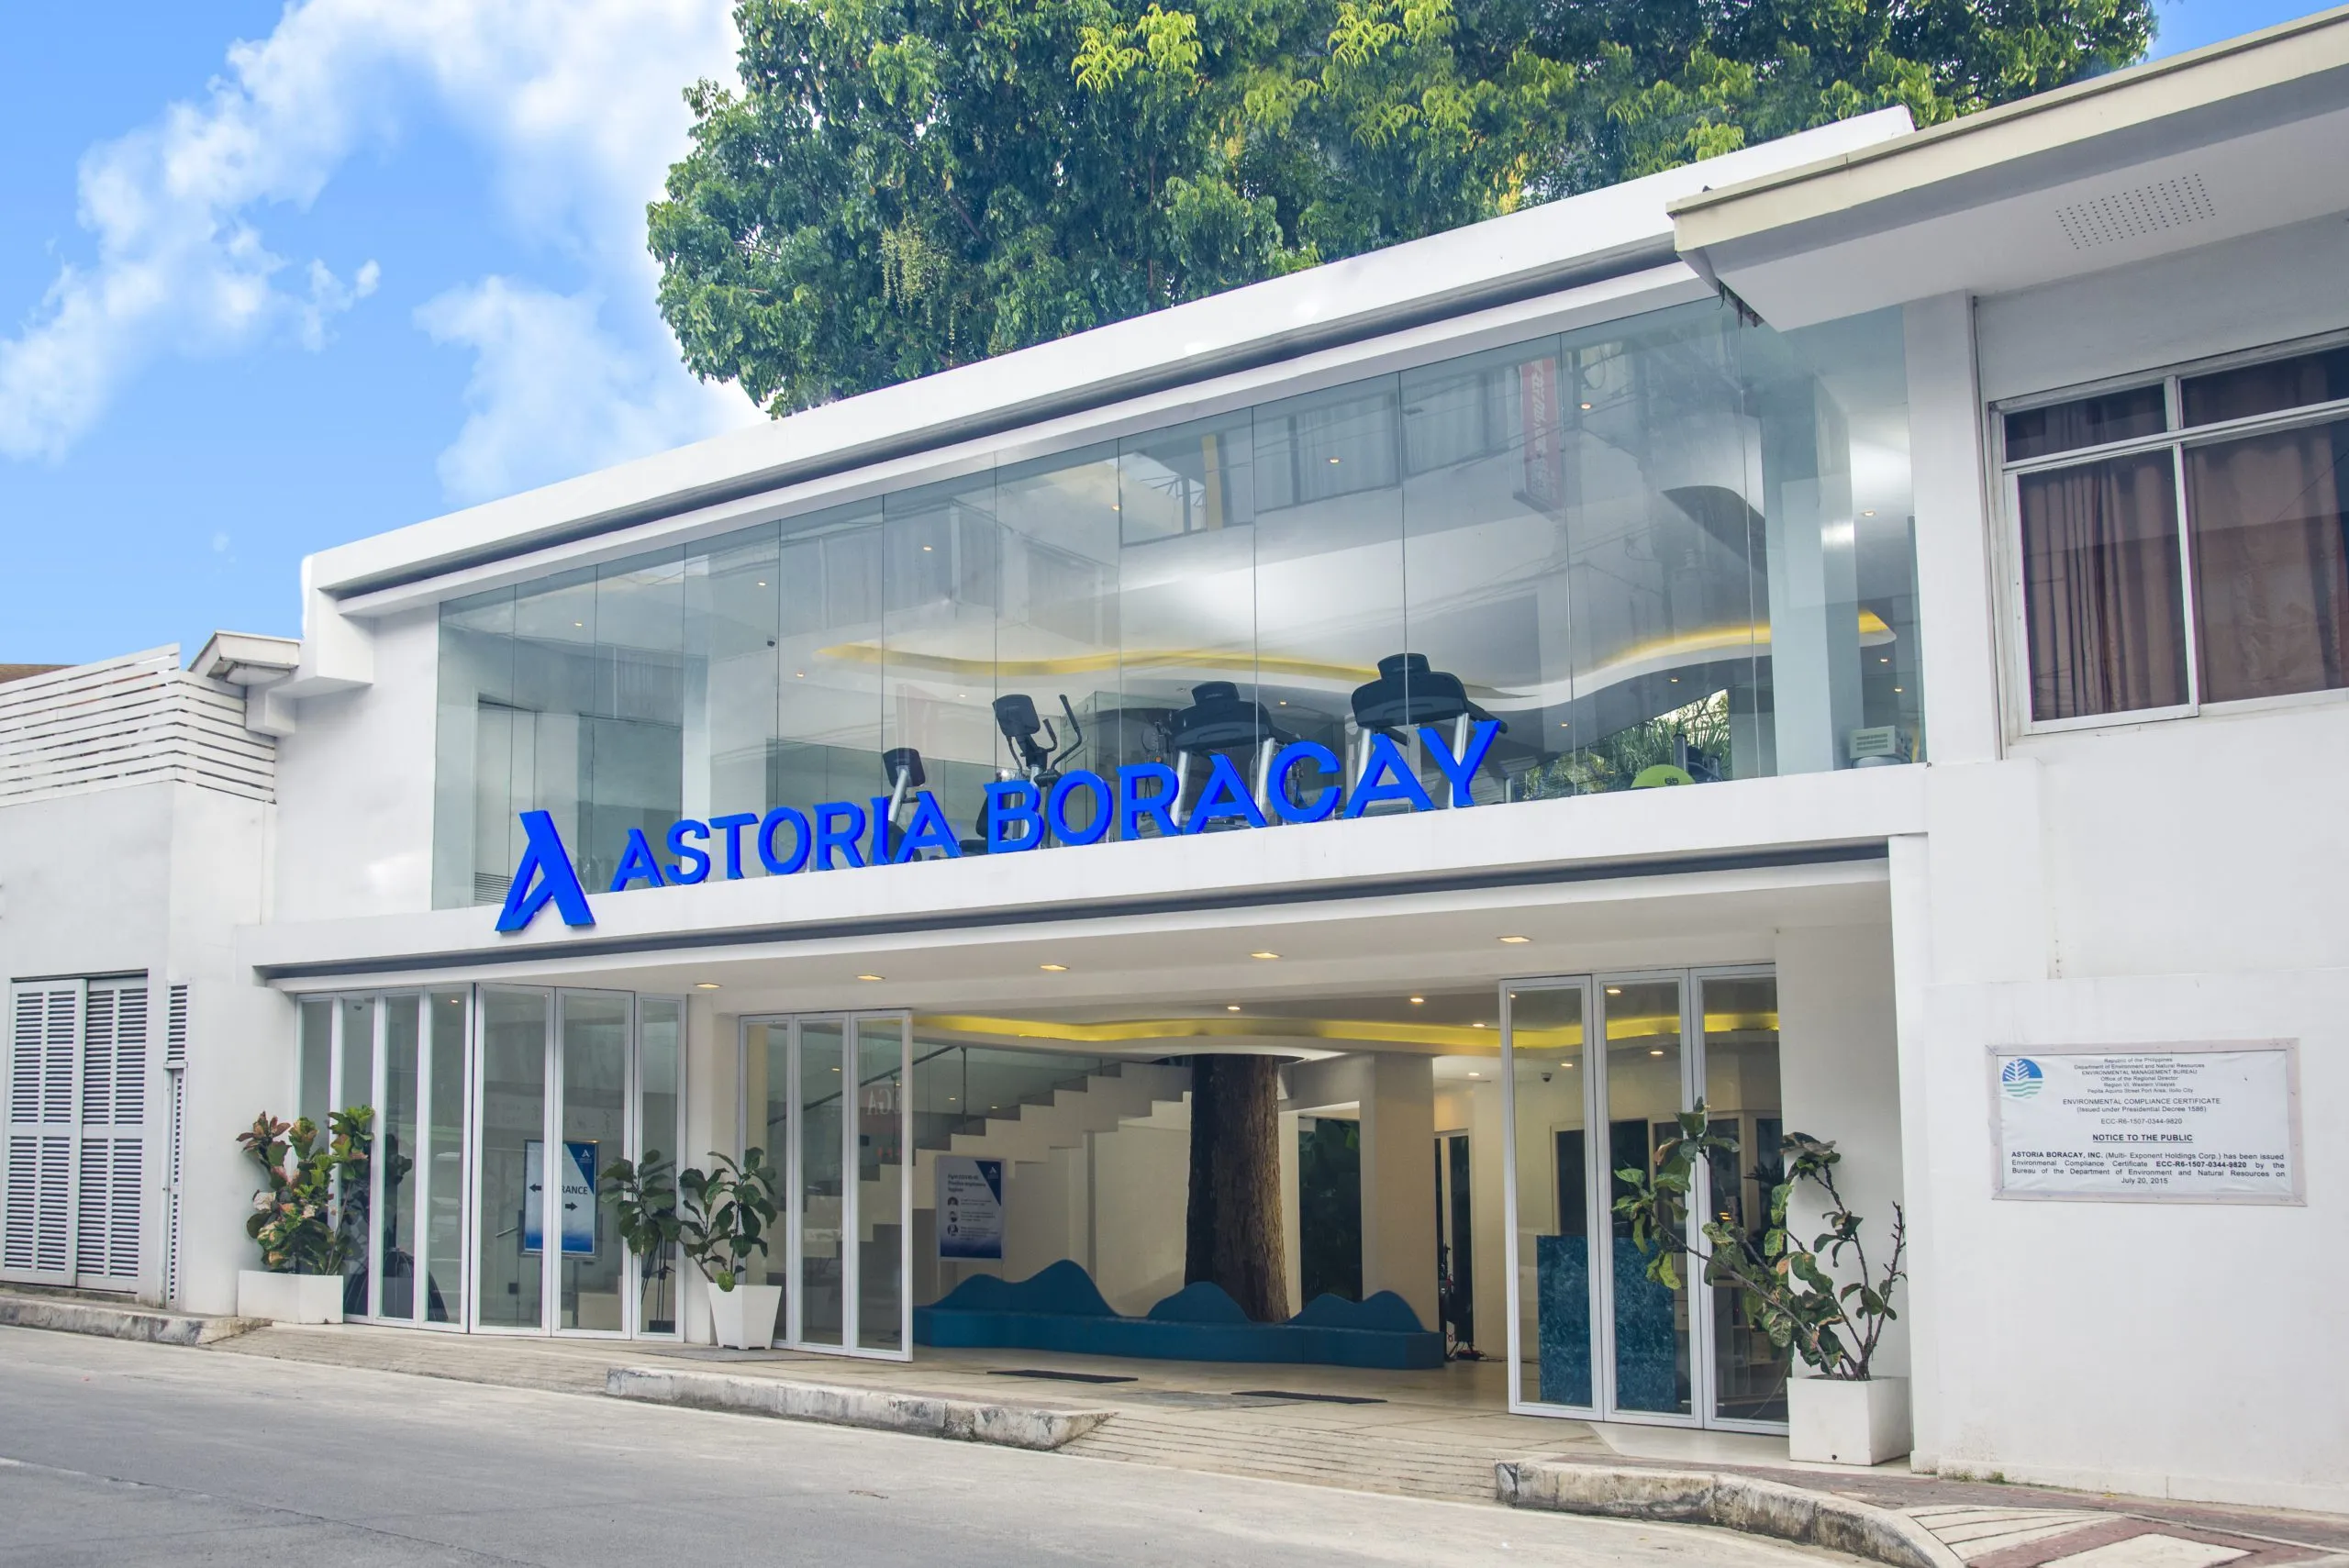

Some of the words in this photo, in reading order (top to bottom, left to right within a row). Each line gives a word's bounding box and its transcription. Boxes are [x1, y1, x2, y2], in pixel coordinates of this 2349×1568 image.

[610, 790, 963, 893] ASTORIA
[984, 720, 1502, 854] BORACAY
[562, 1185, 588, 1195] RANCE
